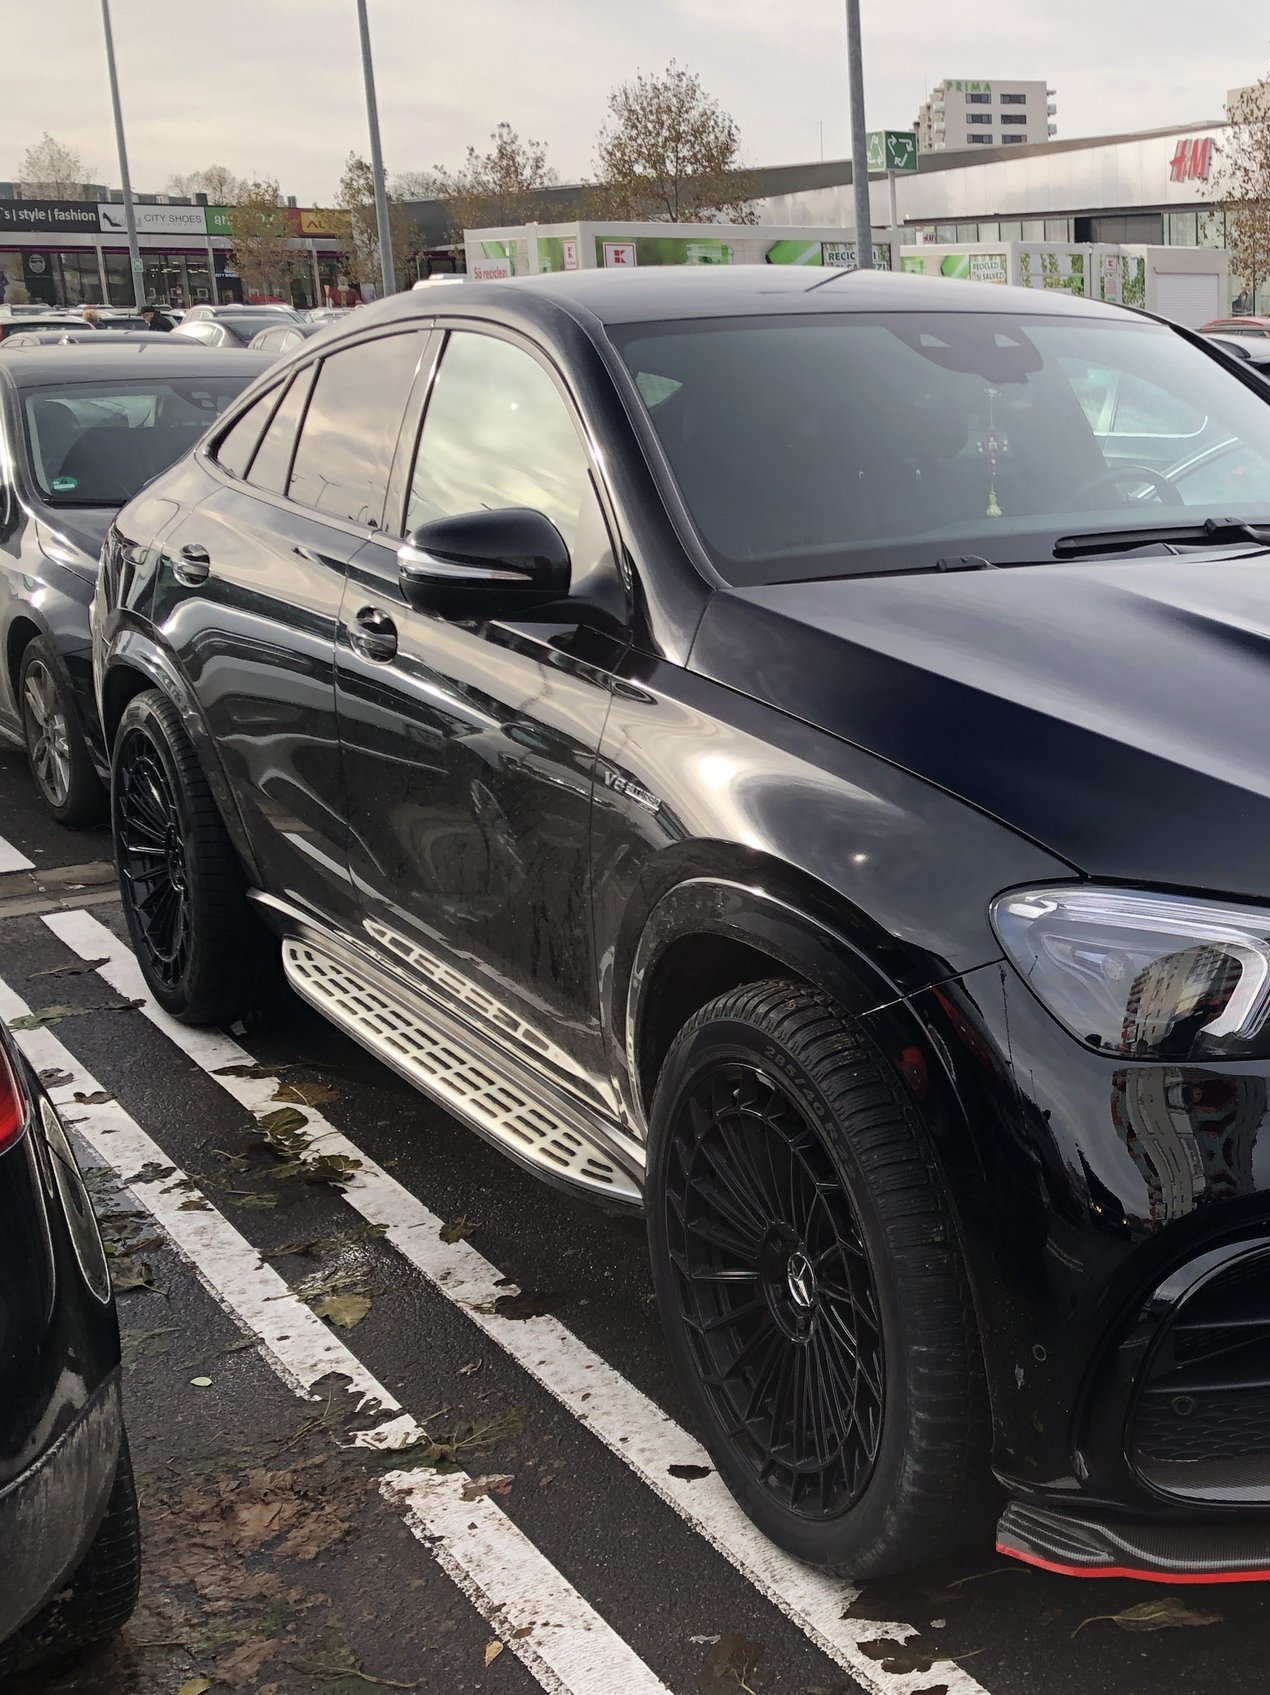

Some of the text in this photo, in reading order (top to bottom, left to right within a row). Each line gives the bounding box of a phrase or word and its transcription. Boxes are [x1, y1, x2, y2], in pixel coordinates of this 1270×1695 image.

[947, 81, 992, 92] PRIMA
[1169, 137, 1210, 182] H&M
[19, 208, 46, 222] style
[54, 208, 96, 221] fashion
[144, 214, 166, 222] CITY
[168, 215, 202, 224] SHOES
[764, 1046, 825, 1116] 285/40
